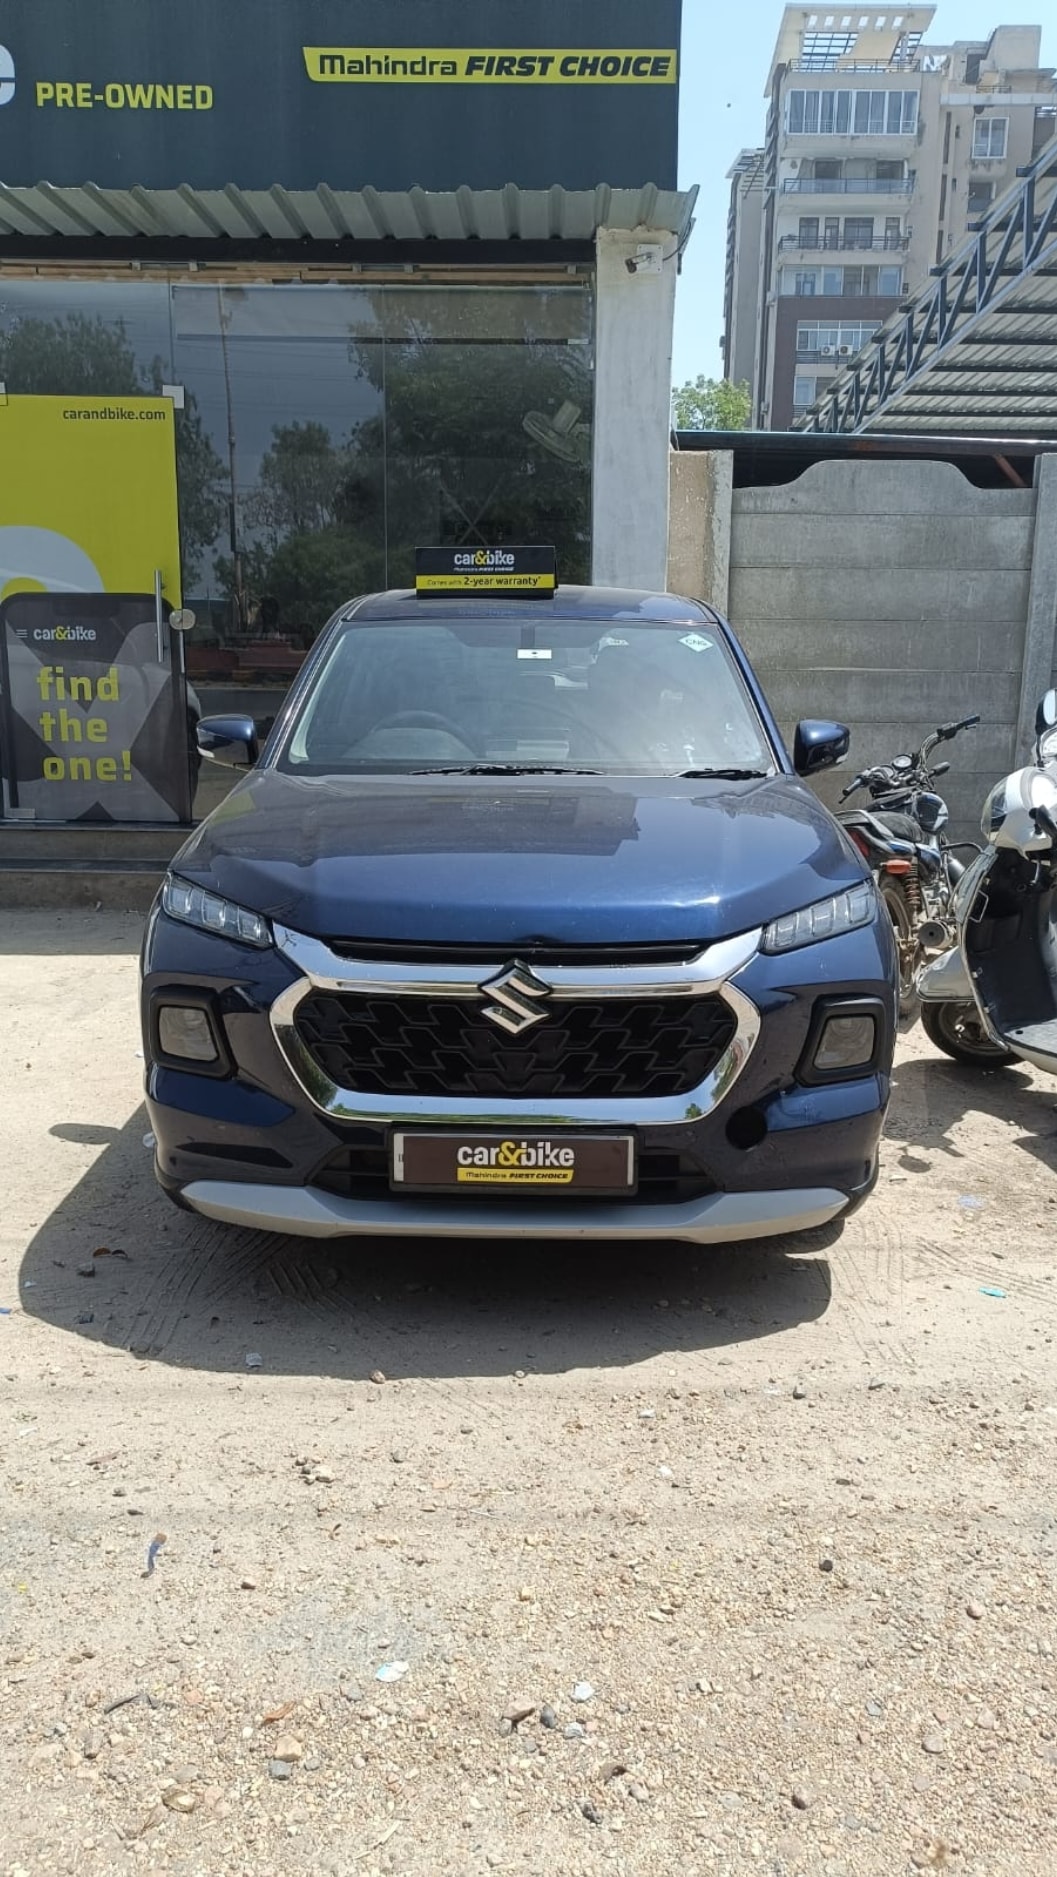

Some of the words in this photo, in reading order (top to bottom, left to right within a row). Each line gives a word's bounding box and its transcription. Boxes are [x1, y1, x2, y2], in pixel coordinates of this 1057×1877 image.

[318, 54, 457, 77] Mahindra
[464, 55, 553, 77] FIRST
[559, 55, 671, 77] CHOICE
[36, 81, 213, 110] PRE-OWNED
[63, 407, 166, 421] carandbike.com
[454, 550, 515, 566] car&bike
[463, 576, 493, 587] 2-year
[33, 626, 97, 641] car&bike
[36, 666, 120, 701] find
[39, 708, 108, 743] the
[43, 751, 132, 782] one!
[457, 1141, 575, 1167] car&bike
